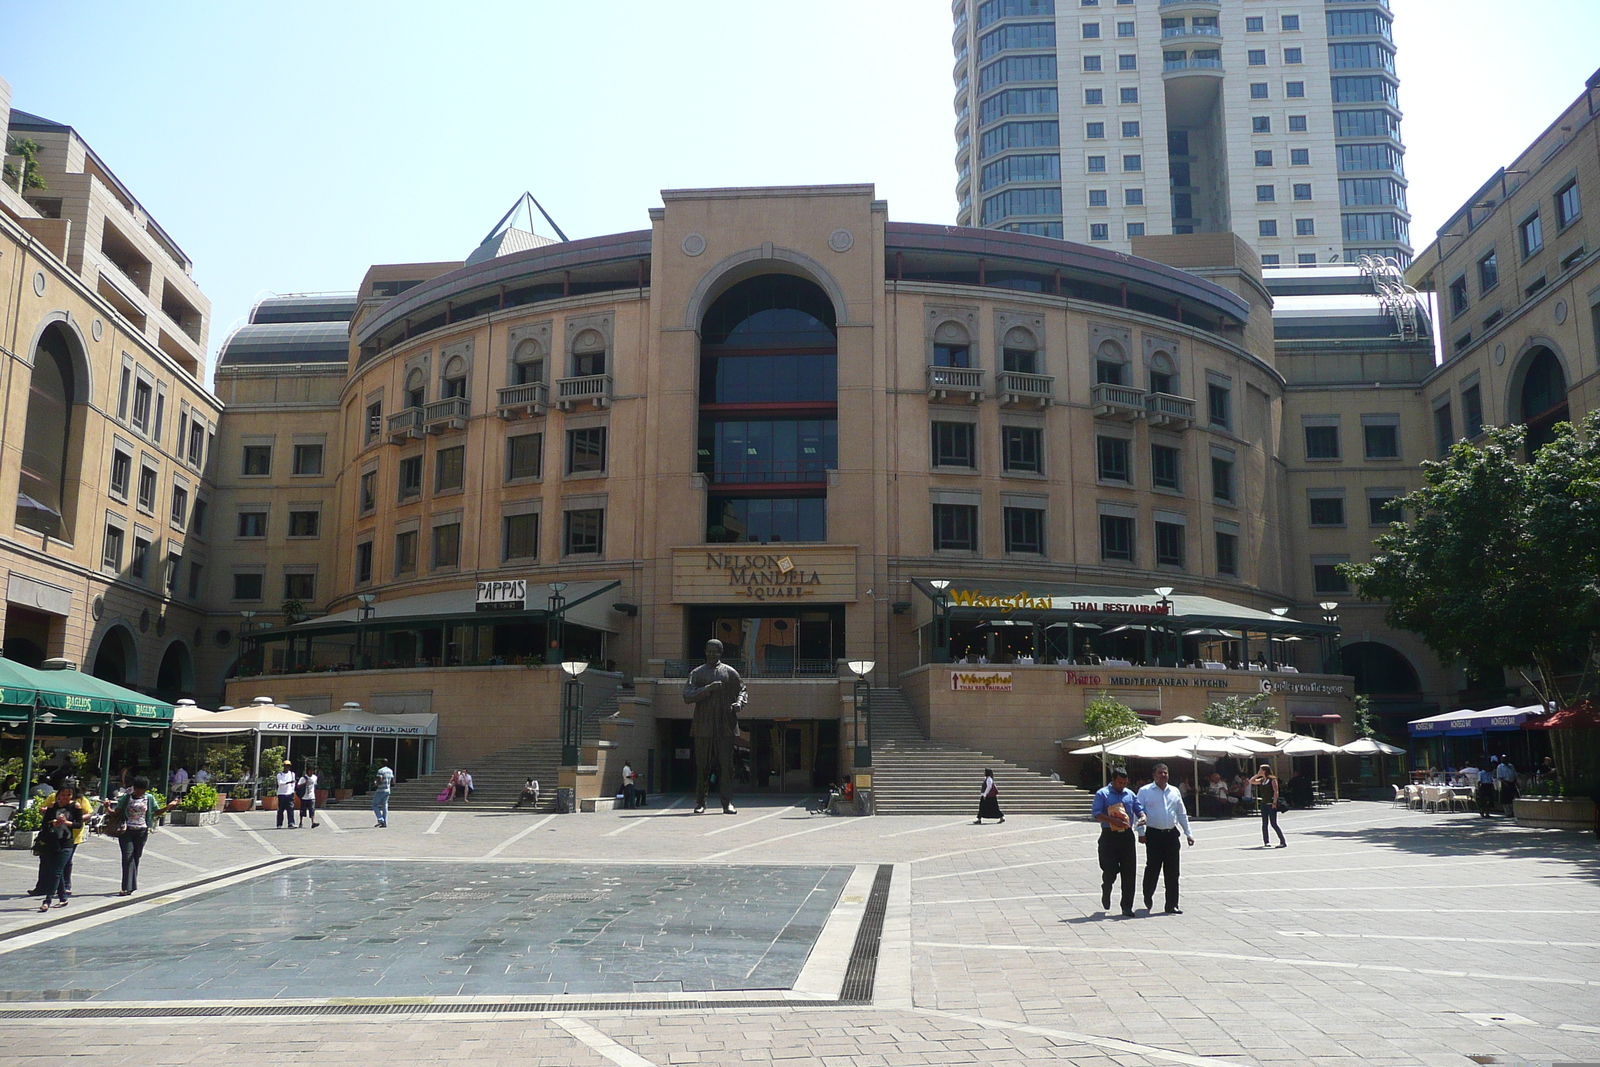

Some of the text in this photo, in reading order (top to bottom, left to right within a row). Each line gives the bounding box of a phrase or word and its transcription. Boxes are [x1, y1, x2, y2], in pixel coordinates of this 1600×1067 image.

[706, 552, 780, 570] NELSON
[729, 565, 821, 586] MANDELA
[476, 580, 525, 600] PAPPAS
[746, 586, 802, 601] SQUARE
[950, 588, 1053, 613] Wangthai
[1070, 601, 1172, 615] THAI RESTAURANT
[959, 673, 1012, 686] Wangthai
[1065, 670, 1228, 688] Piatto MEDITERRANEAN KITCHEN
[291, 722, 313, 731] DELLA
[316, 723, 341, 731] SALUTE
[376, 725, 395, 733] DELLA
[398, 726, 419, 734] SALUTE
